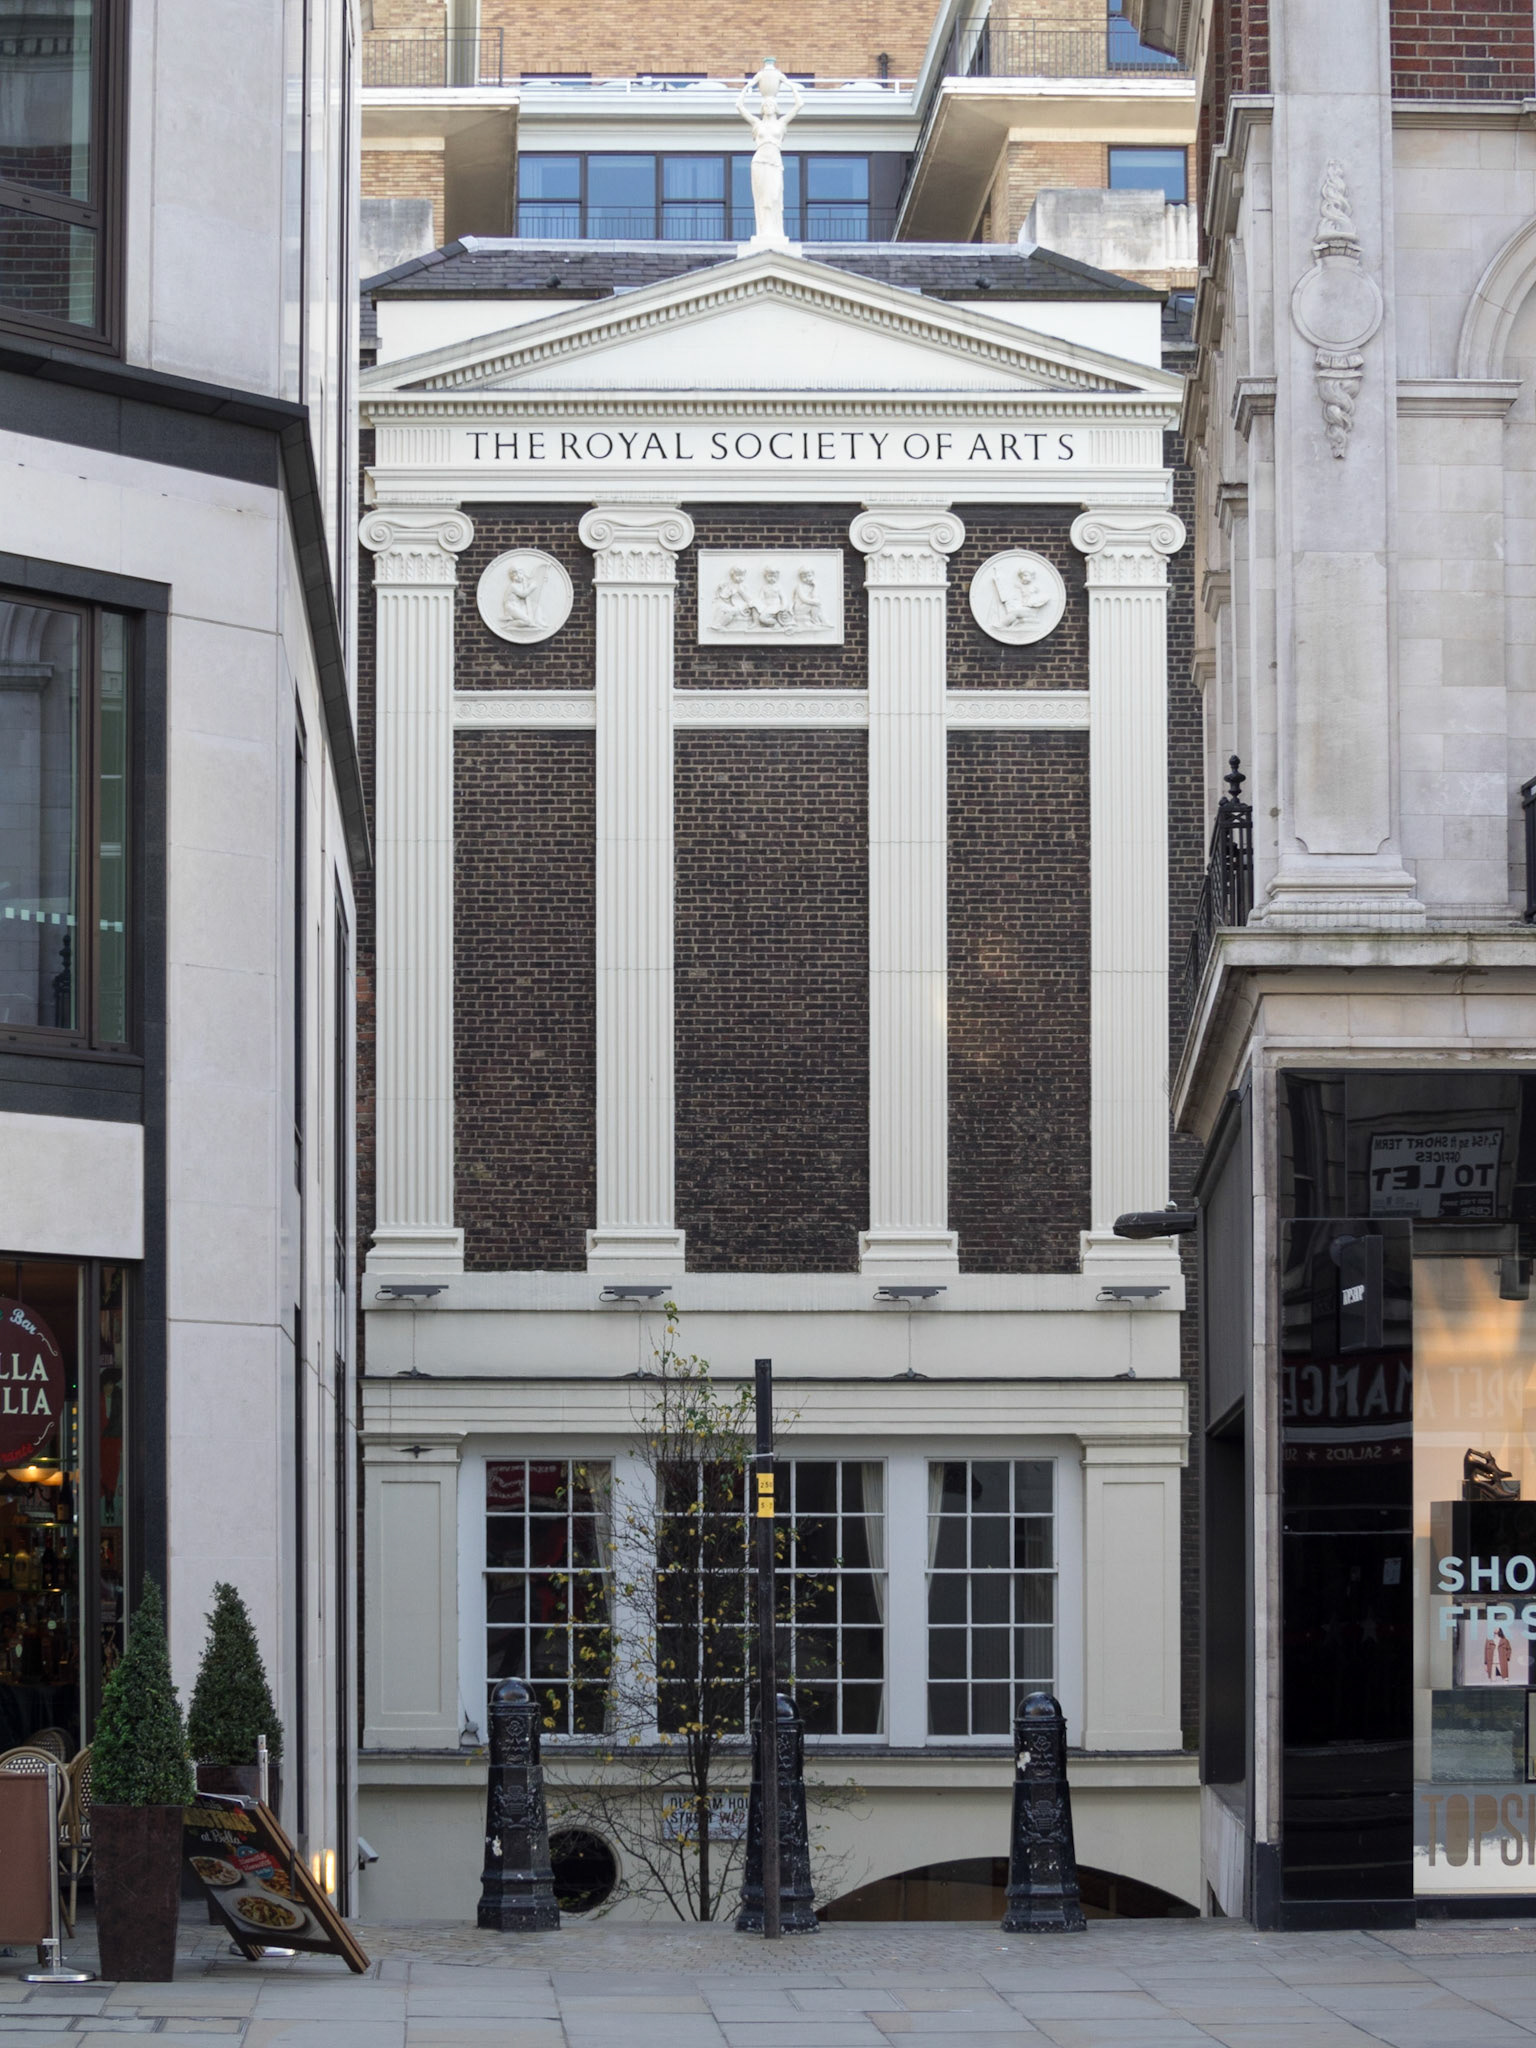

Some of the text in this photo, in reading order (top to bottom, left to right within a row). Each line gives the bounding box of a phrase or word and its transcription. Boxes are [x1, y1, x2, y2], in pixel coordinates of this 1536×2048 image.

[466, 432, 1074, 461] THE ROYAL SOCIETY OF ARTS
[10, 1308, 37, 1335] Bar
[2, 1386, 52, 1416] LIA
[1437, 1555, 1536, 1592] SHO
